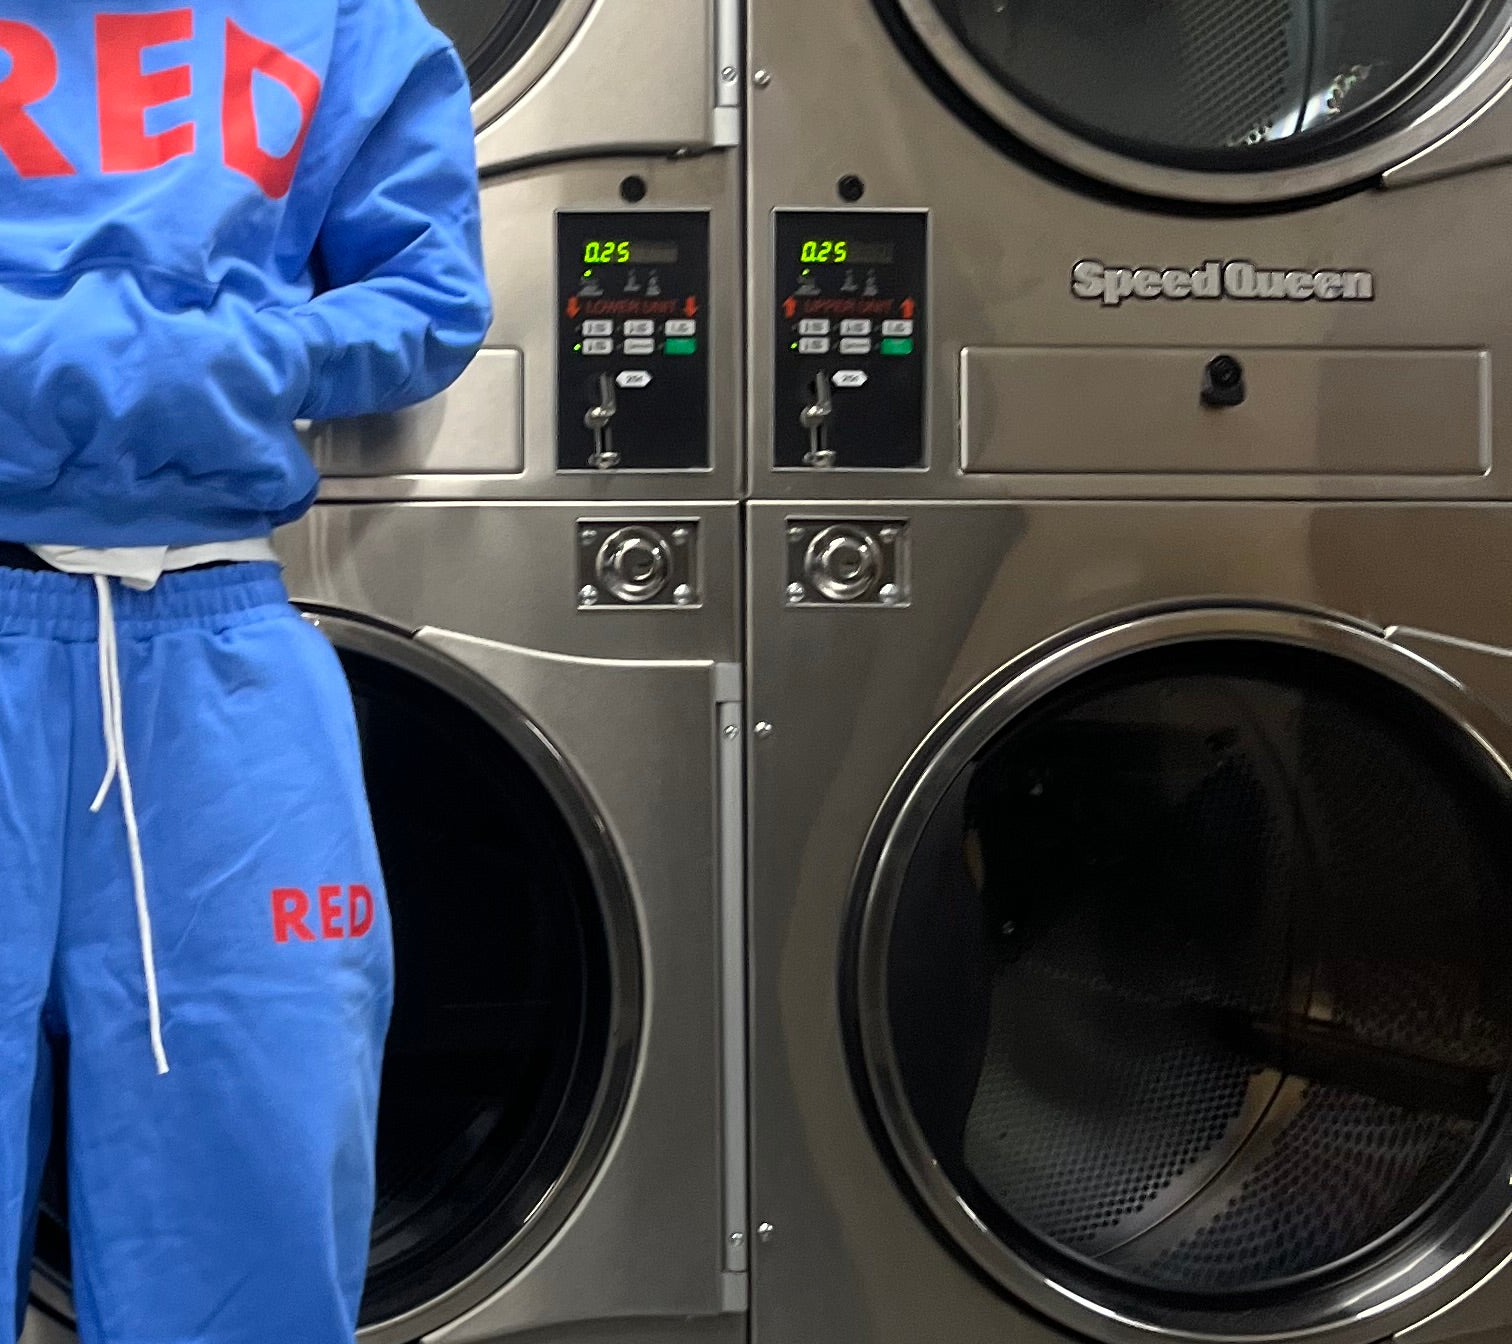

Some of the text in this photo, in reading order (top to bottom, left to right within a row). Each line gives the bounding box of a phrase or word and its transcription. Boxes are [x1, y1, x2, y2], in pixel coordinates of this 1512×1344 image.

[584, 241, 630, 263] 0.25
[800, 241, 847, 263] 0.25
[1070, 259, 1375, 307] Speed Queen
[271, 884, 375, 944] RED
